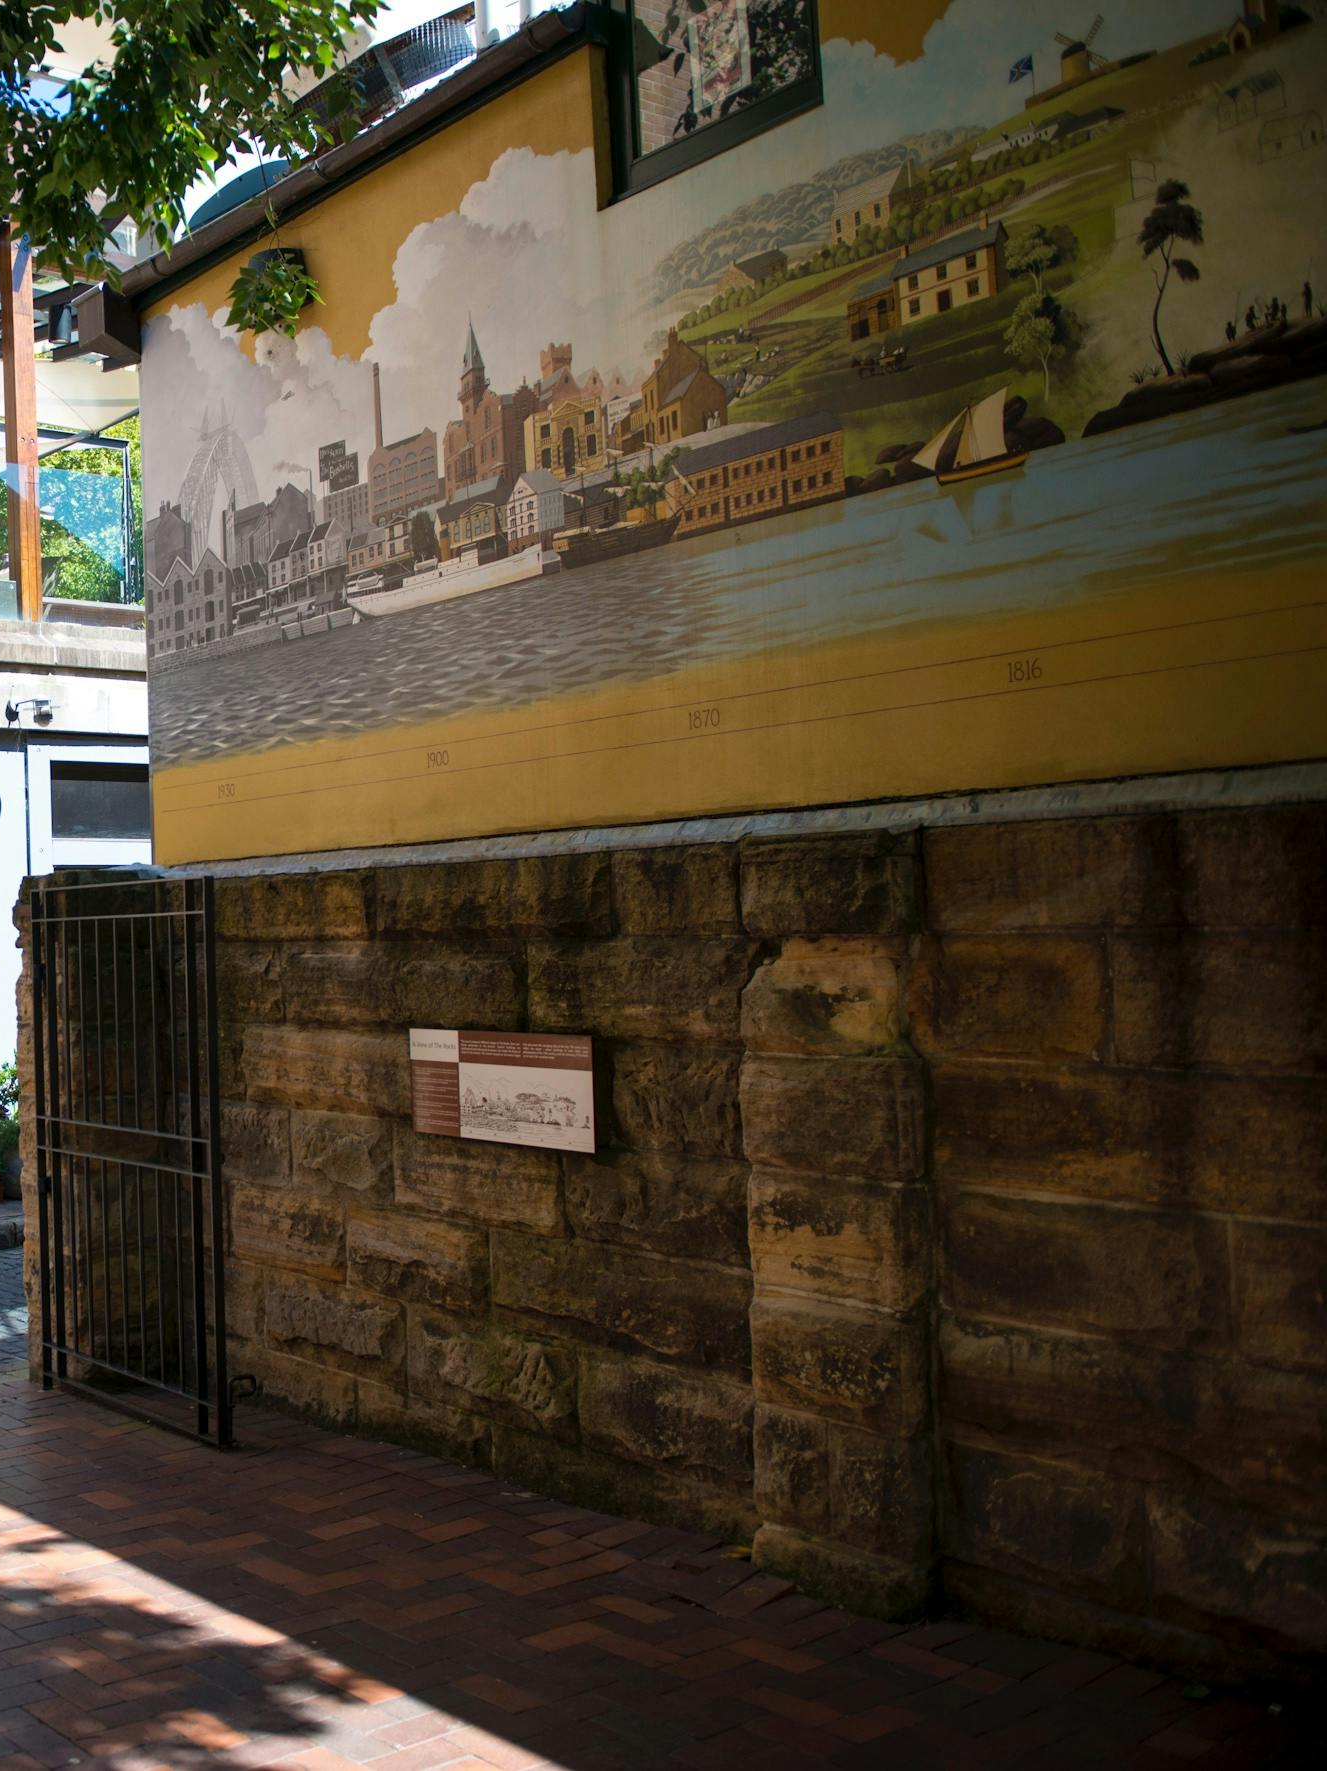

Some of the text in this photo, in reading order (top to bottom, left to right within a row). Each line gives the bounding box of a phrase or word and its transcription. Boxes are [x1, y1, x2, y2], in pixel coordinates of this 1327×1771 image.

[1008, 657, 1042, 682] 1816
[688, 708, 720, 730] 1870
[427, 750, 449, 768] 1900
